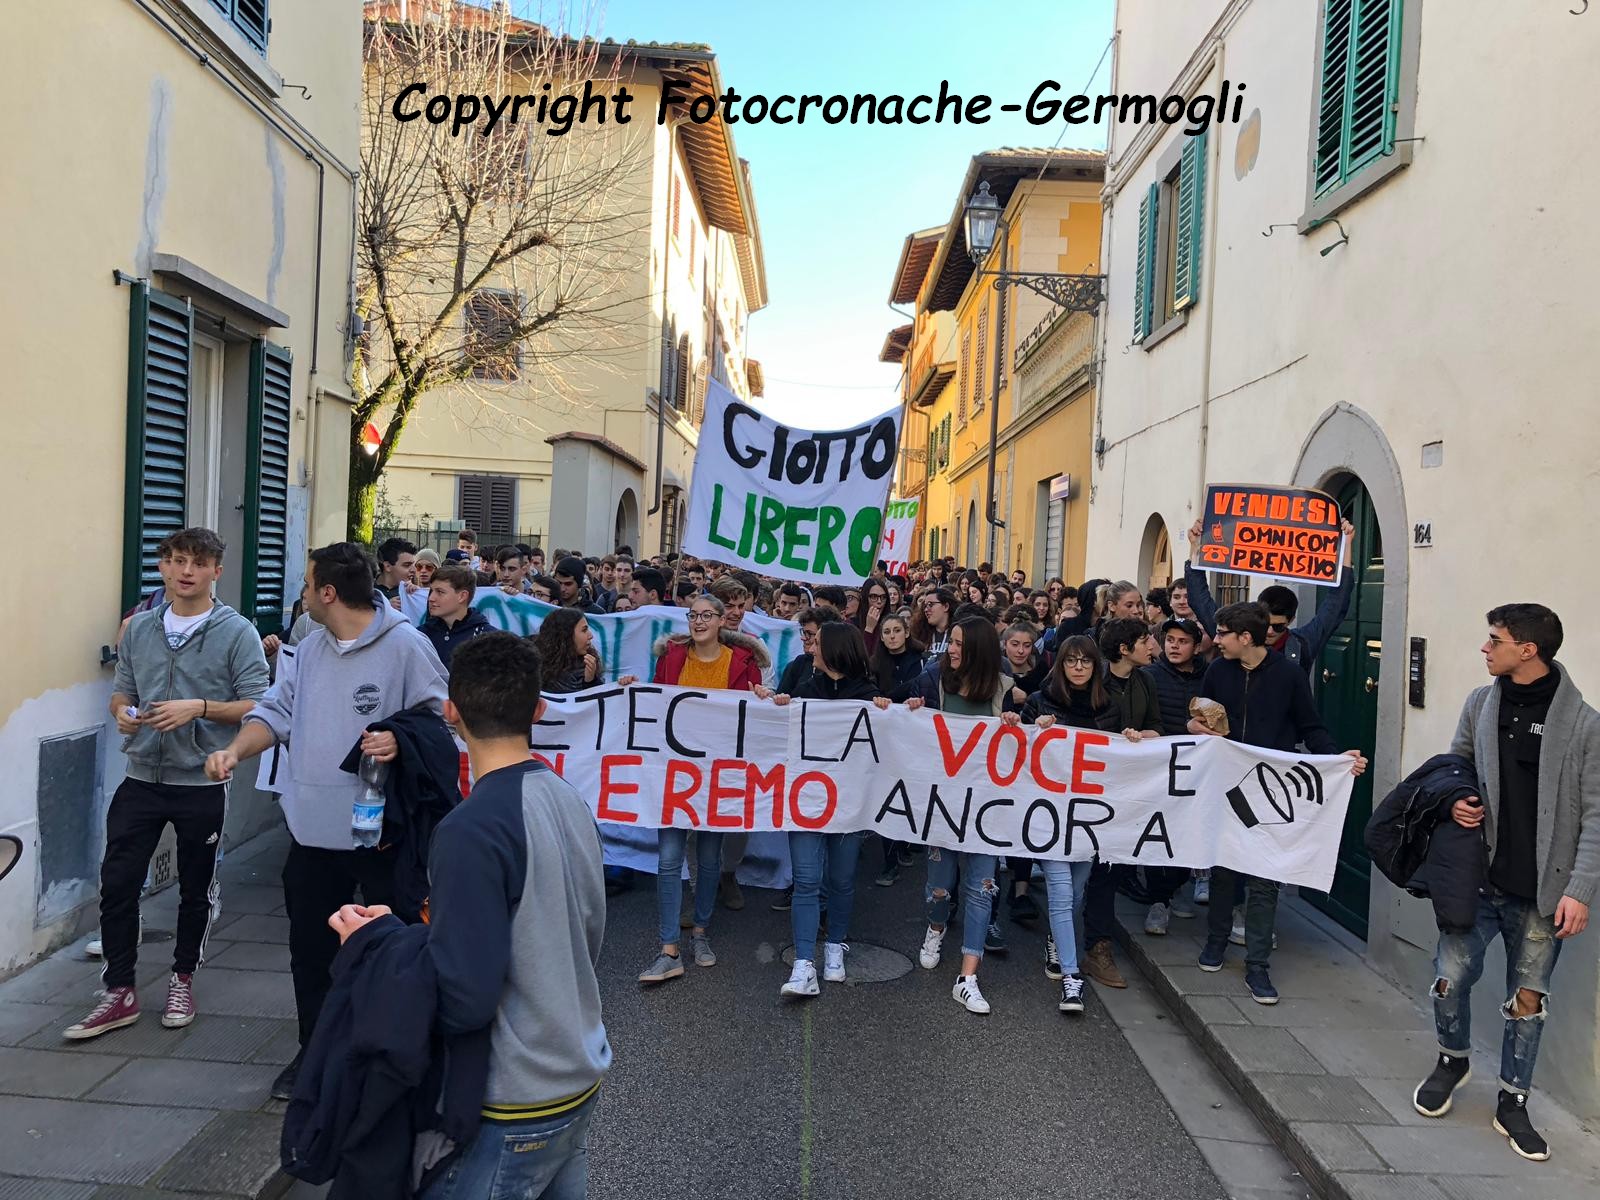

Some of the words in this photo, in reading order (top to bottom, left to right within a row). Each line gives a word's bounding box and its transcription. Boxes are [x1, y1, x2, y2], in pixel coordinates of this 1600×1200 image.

[723, 402, 896, 485] GIOTTO
[886, 501, 919, 519] OTTO
[1214, 492, 1337, 526] VENDESI
[708, 483, 883, 578] LIBERO
[1238, 526, 1338, 553] OMNICOM
[1414, 523, 1432, 545] 164
[1233, 548, 1336, 577] PRENSIVO
[529, 686, 747, 759] ETECI
[801, 700, 880, 764] LA
[933, 713, 1110, 795] VOCE
[1168, 741, 1197, 797] E
[533, 752, 838, 829] EREMO
[875, 779, 1174, 859] ANCORA
